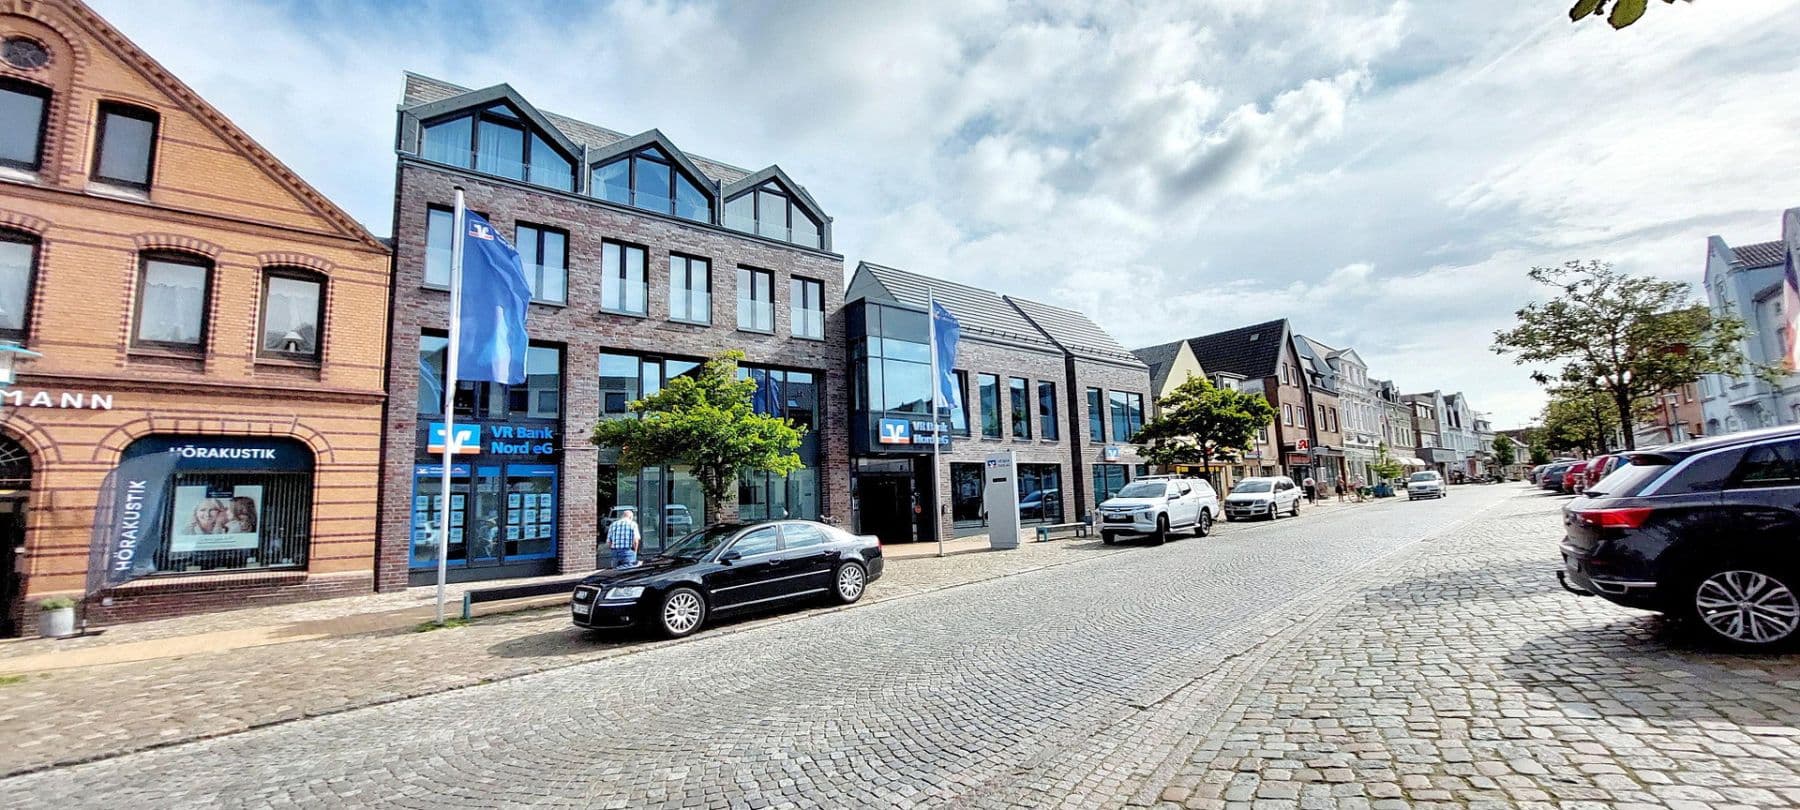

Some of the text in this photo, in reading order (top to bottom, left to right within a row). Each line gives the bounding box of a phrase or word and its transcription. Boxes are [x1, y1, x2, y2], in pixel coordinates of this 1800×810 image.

[491, 425, 553, 439] VR Bank
[926, 421, 948, 432] Bnk
[491, 441, 553, 455] Nord eG
[113, 480, 148, 571] HÖRAKUSTIK
